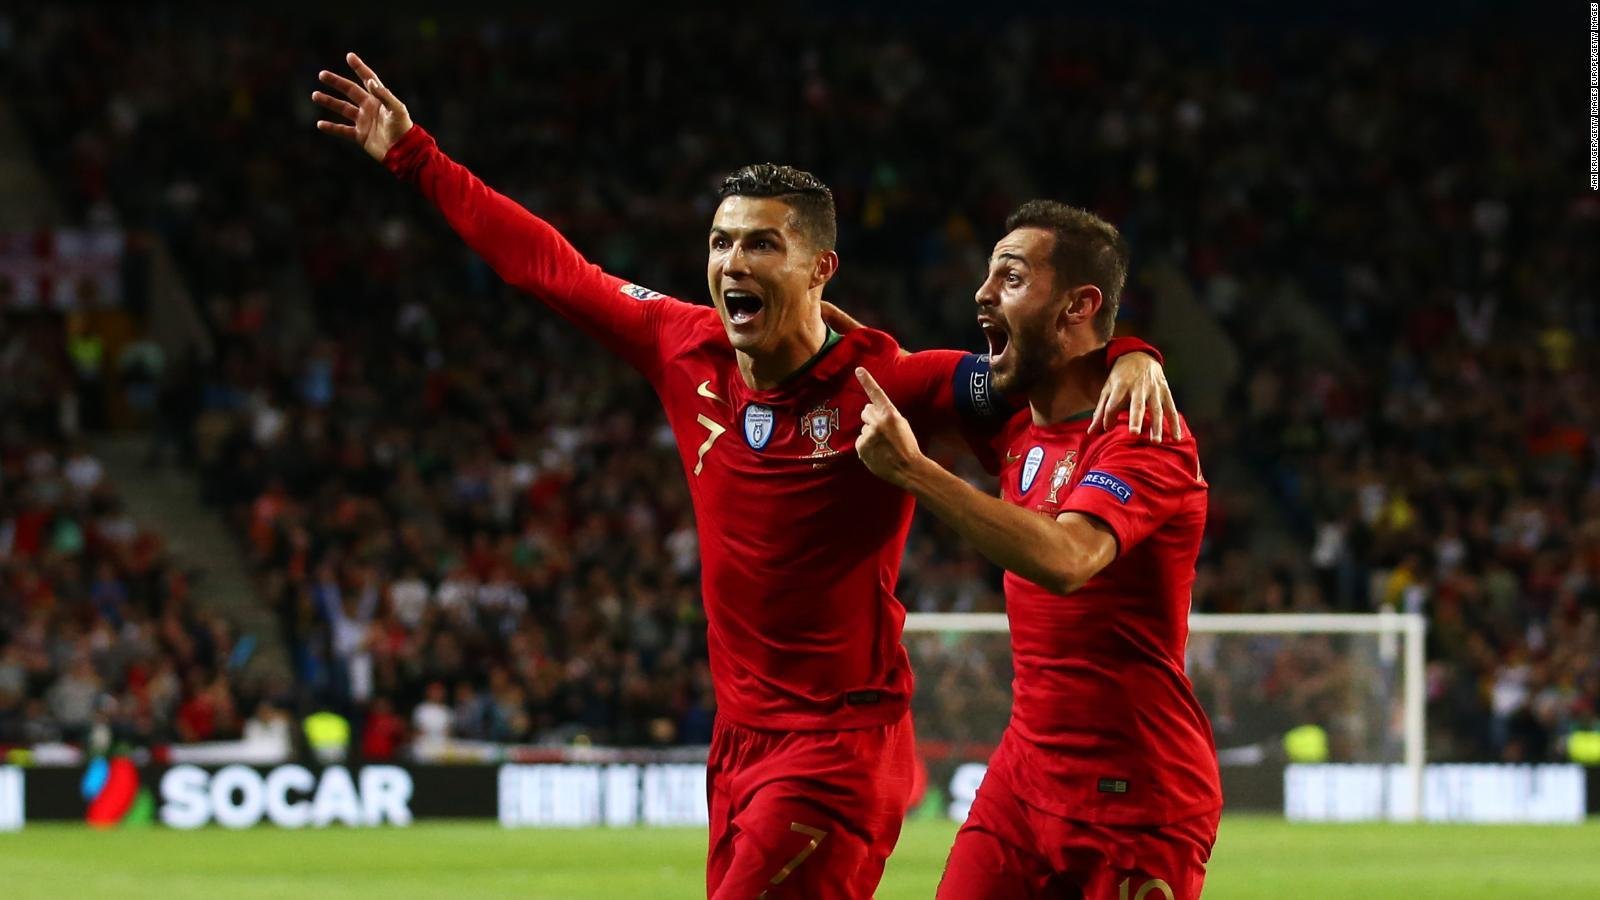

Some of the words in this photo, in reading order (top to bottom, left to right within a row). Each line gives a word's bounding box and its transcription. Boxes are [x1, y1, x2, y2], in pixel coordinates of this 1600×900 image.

[973, 372, 989, 416] SPECT
[694, 413, 726, 477] 7
[1084, 474, 1131, 499] RESPECT
[160, 764, 413, 828] SOCAR
[757, 822, 828, 900] 7
